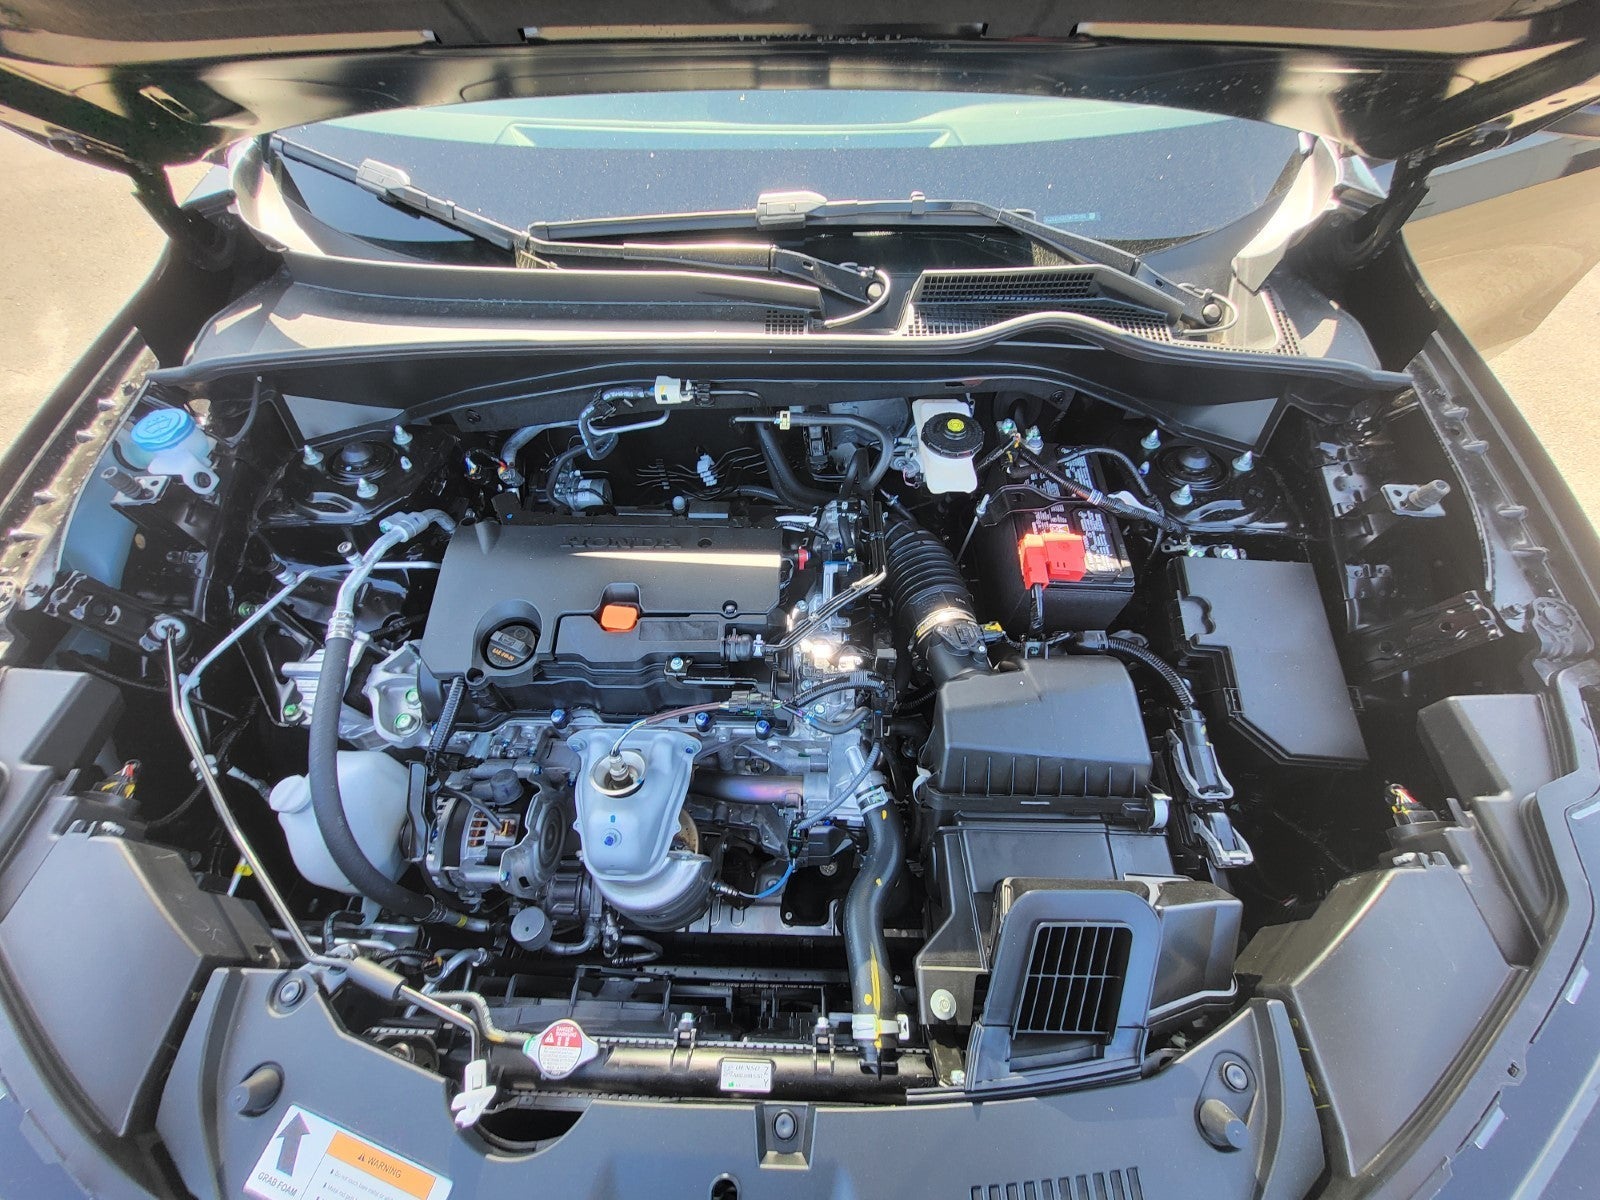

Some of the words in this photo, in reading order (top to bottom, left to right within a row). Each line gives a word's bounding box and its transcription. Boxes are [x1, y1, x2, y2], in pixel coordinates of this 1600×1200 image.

[559, 536, 682, 550] HONDA
[735, 1064, 760, 1072] DENSO
[367, 1156, 402, 1179] WARNING
[257, 1171, 278, 1187] GRAB
[276, 1180, 298, 1197] FOAM
